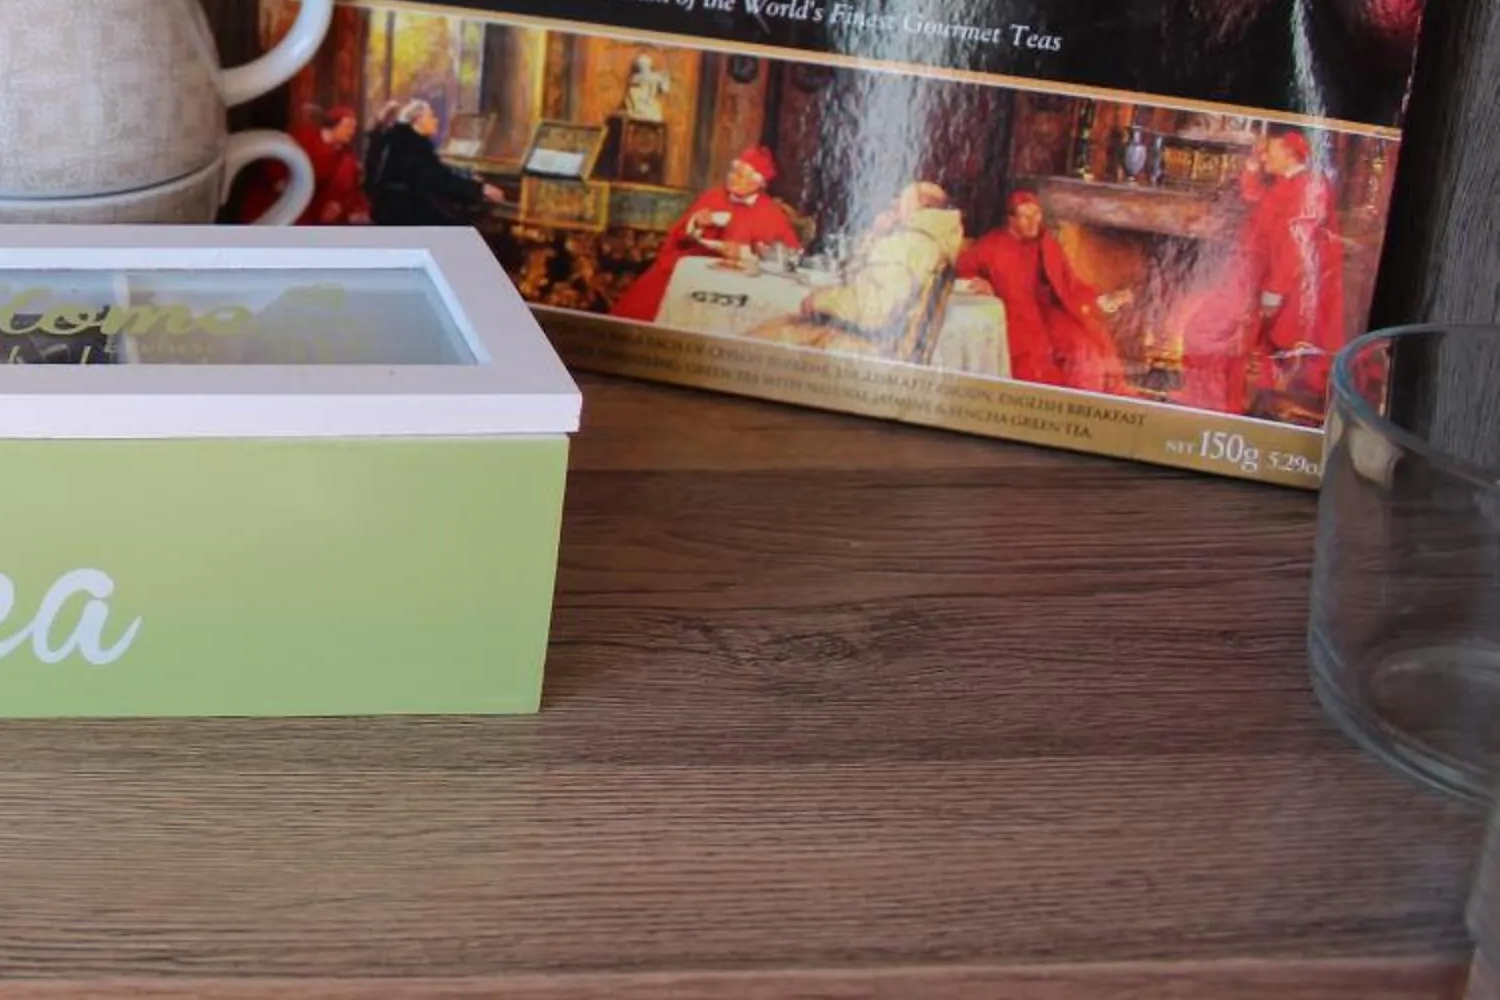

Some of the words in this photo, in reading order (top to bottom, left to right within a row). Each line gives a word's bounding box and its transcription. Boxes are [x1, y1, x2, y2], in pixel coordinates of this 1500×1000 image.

[829, 3, 895, 30] Finest
[903, 13, 1001, 44] Gourmet
[1008, 24, 1063, 51] Teas
[1065, 421, 1092, 439] TEA
[1067, 400, 1146, 428] BREAKFAST
[1200, 429, 1259, 473] 150g
[1266, 450, 1323, 476] 5.29o
